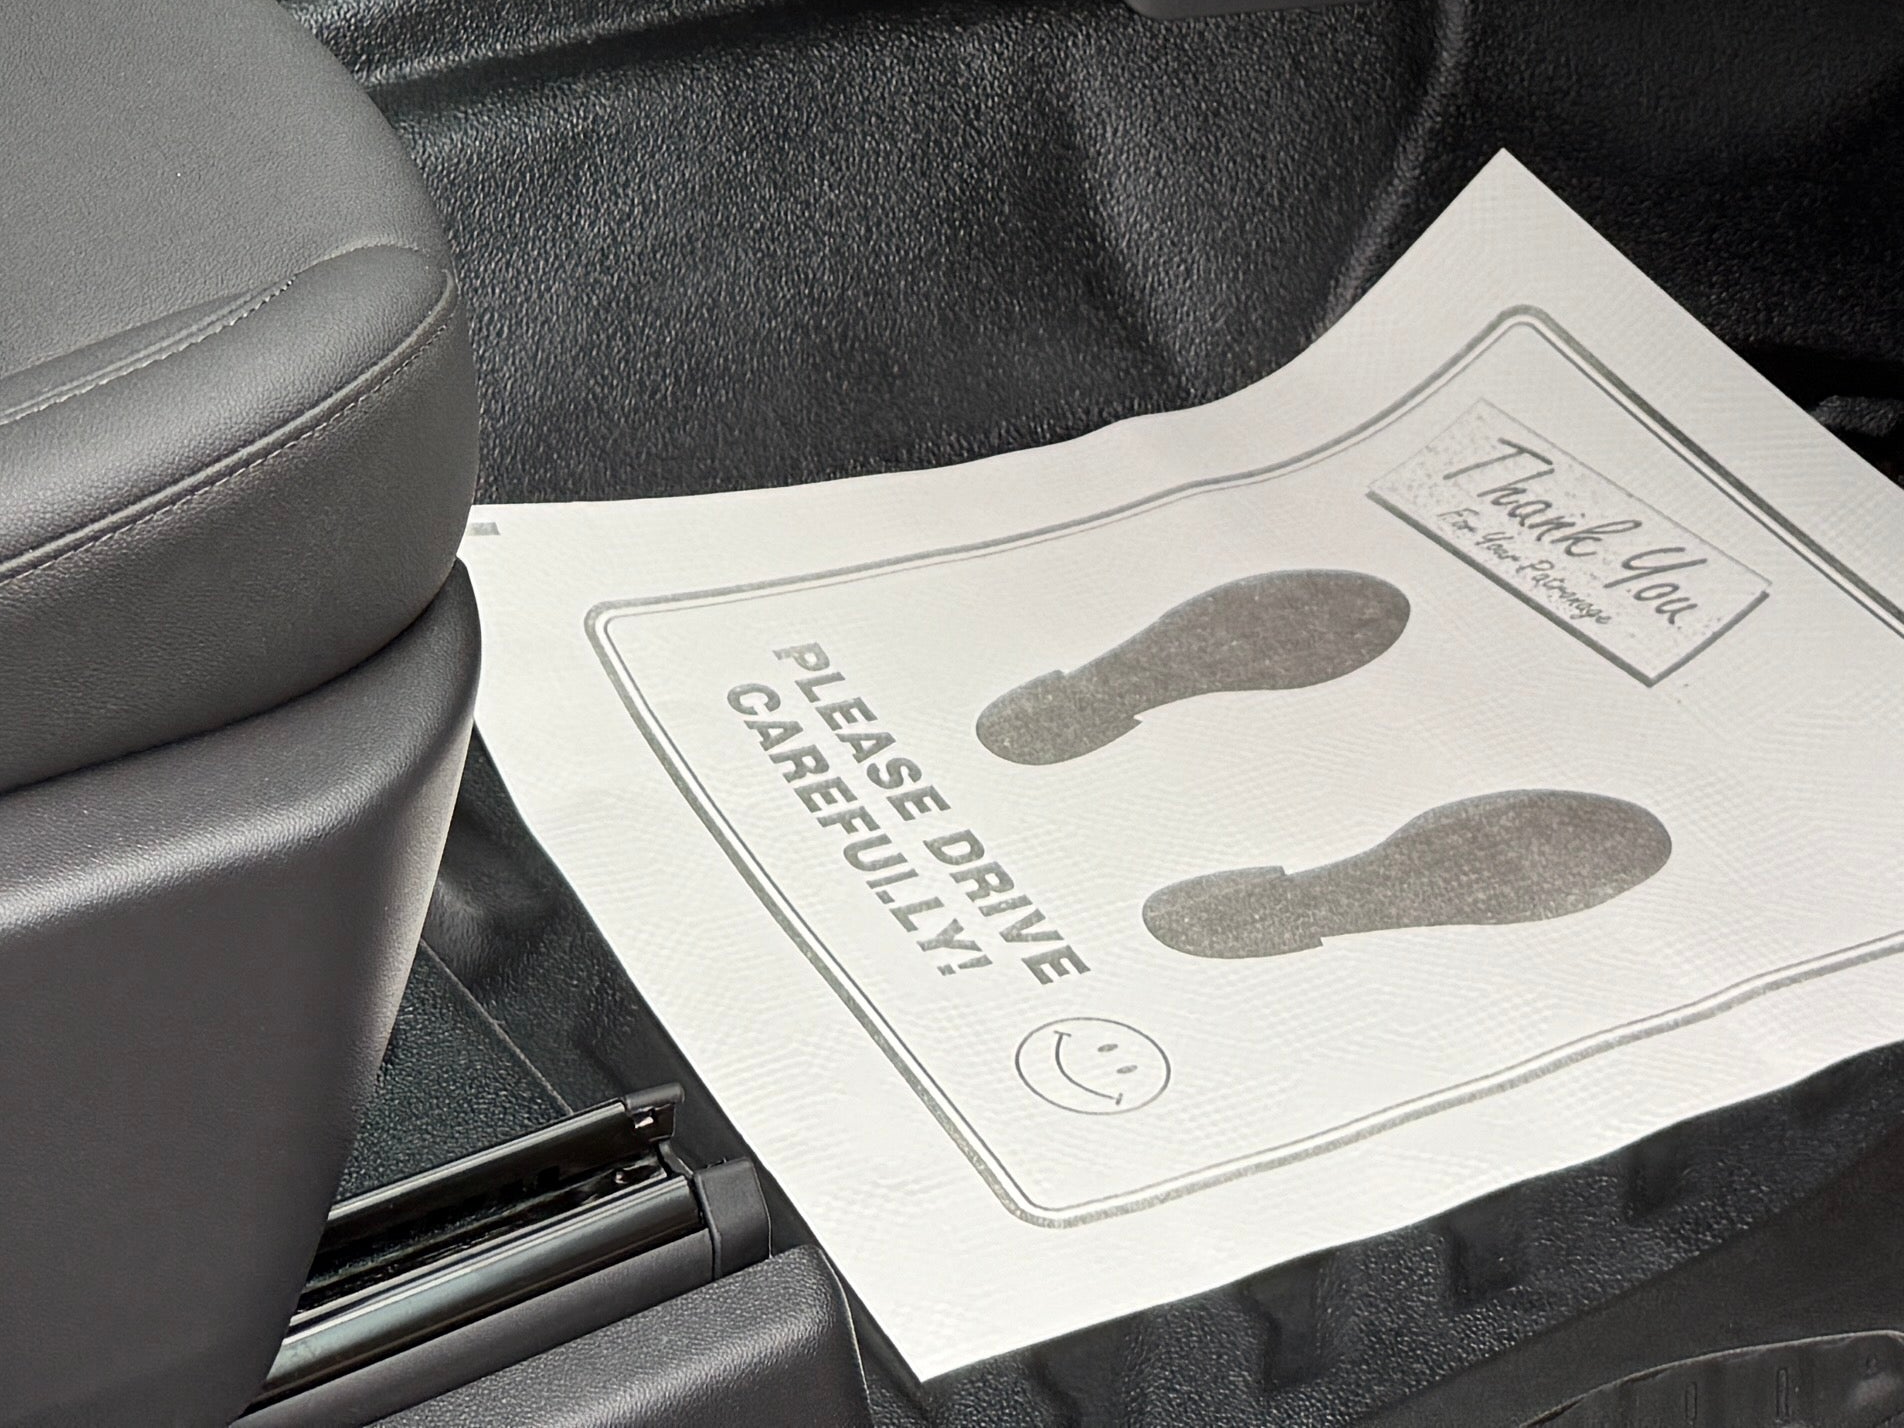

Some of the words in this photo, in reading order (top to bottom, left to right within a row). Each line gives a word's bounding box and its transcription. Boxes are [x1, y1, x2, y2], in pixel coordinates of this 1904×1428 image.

[1437, 507, 1475, 534] For
[1474, 530, 1521, 564] Your
[1519, 558, 1614, 626] Patronage
[1442, 437, 1642, 558] Thank
[1604, 546, 1708, 626] You
[726, 682, 993, 977] CAREFULLY!
[772, 642, 952, 822] PLEASE
[922, 828, 1092, 986] DRIVE
